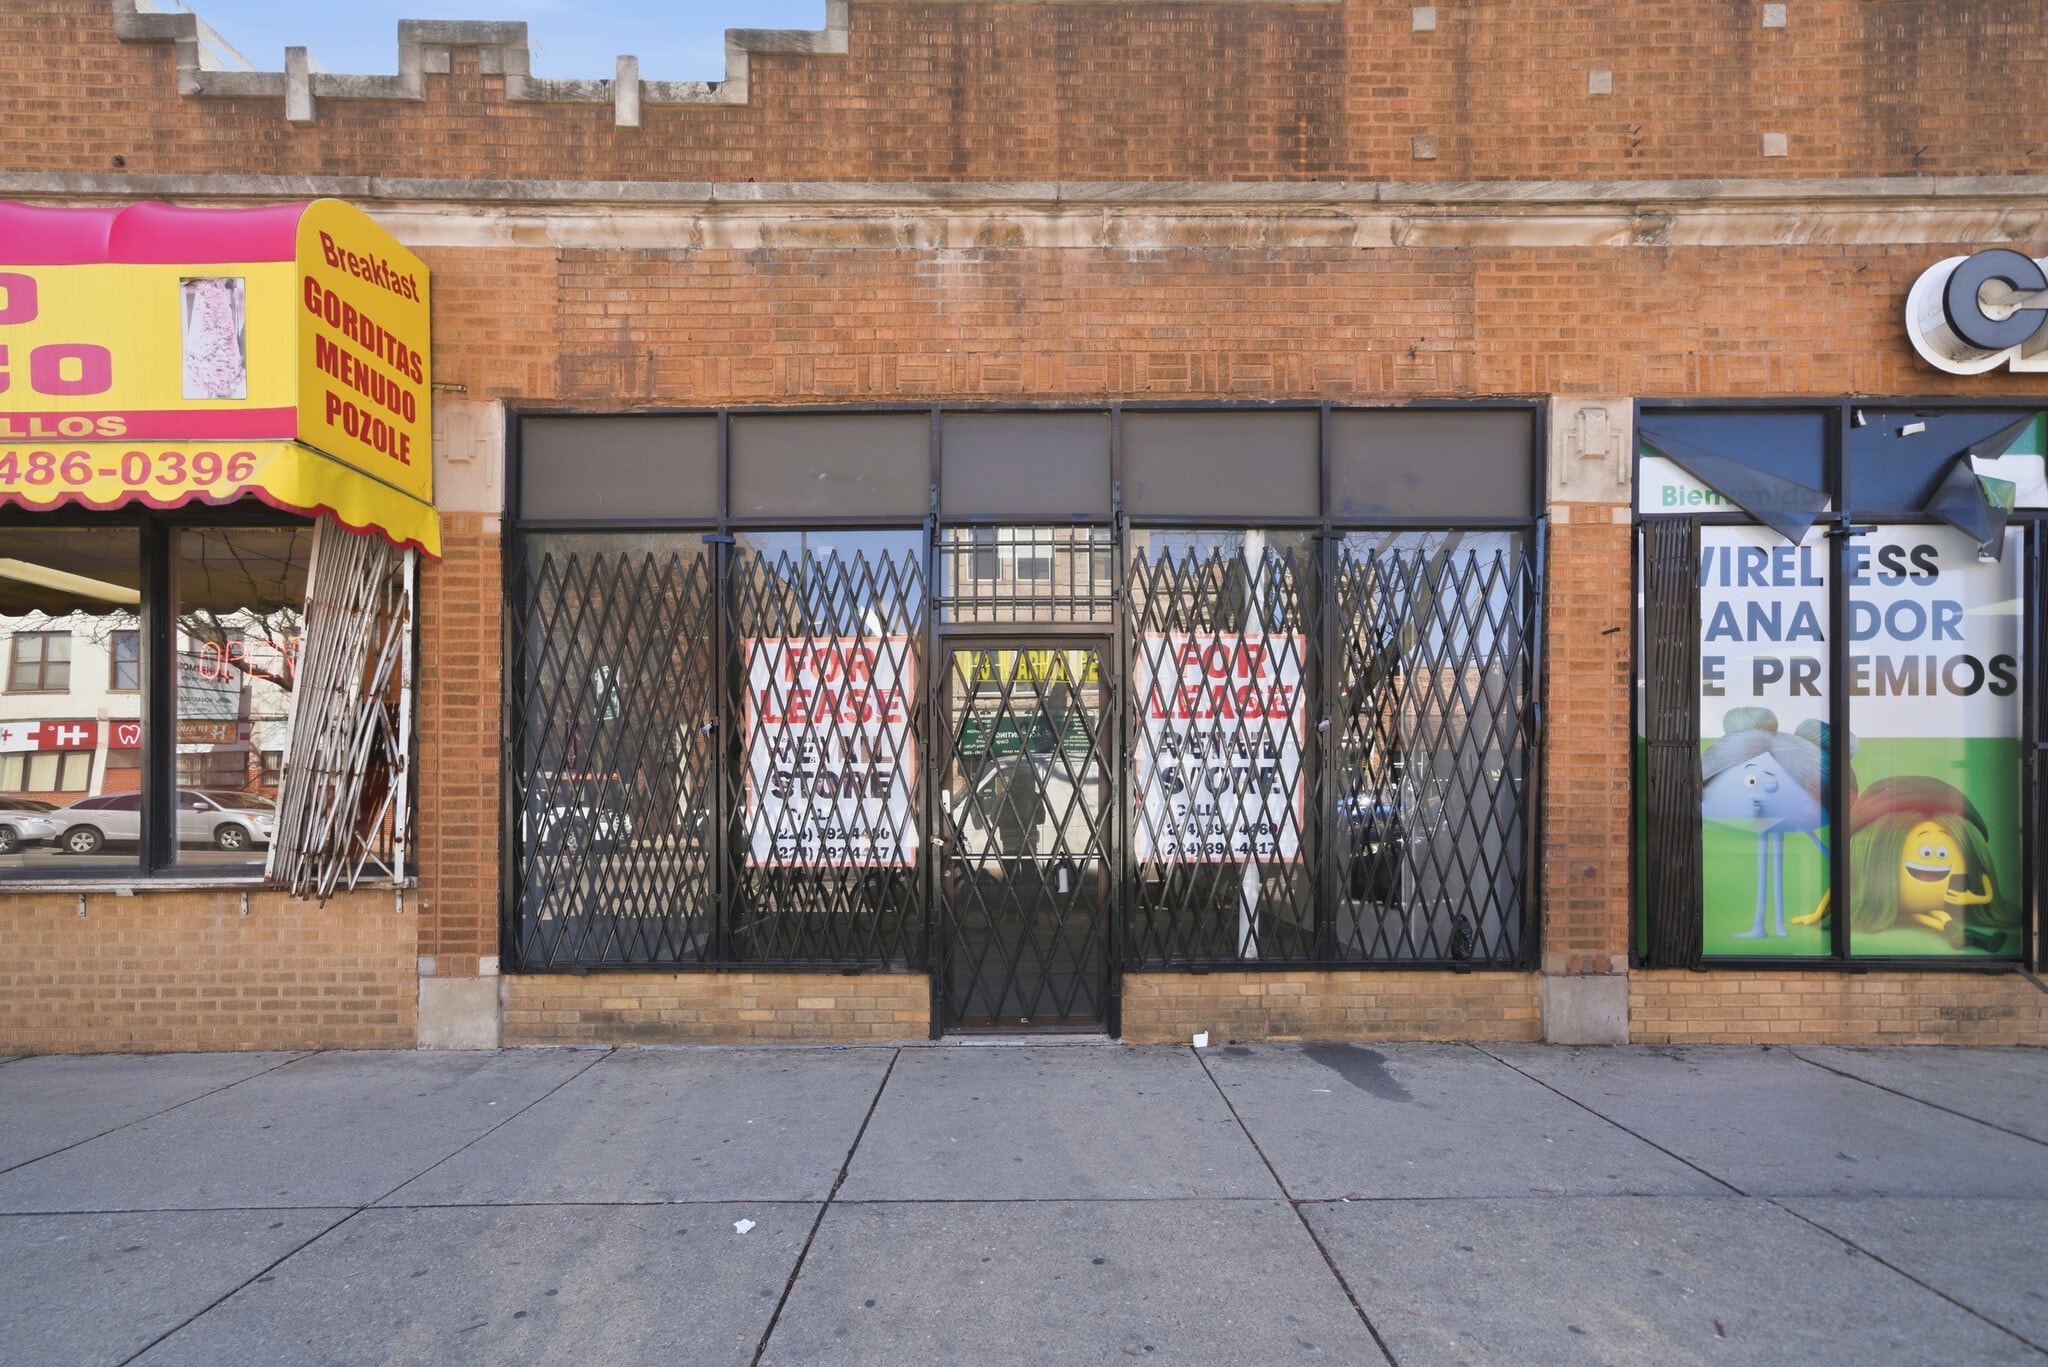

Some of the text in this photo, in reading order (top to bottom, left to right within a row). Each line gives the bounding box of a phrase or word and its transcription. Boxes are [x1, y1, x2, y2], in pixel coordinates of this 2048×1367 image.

[319, 230, 420, 303] Breakfast
[304, 275, 423, 385] GORDITAS
[0, 343, 112, 396] O
[315, 332, 416, 424] MENUDO
[326, 390, 411, 466] POZOLE
[0, 451, 257, 486] 486-0396
[1700, 544, 1940, 587] IRELESS
[1700, 600, 1965, 643] ANADOR
[199, 637, 299, 679] OPEN
[784, 647, 876, 683] FOR
[1176, 643, 1268, 679] FOR
[1752, 654, 2019, 697] PREMIOS
[760, 688, 902, 724] LEASE
[1151, 684, 1293, 720] LEASE
[771, 770, 892, 799] STORE
[1161, 766, 1281, 795] STORE
